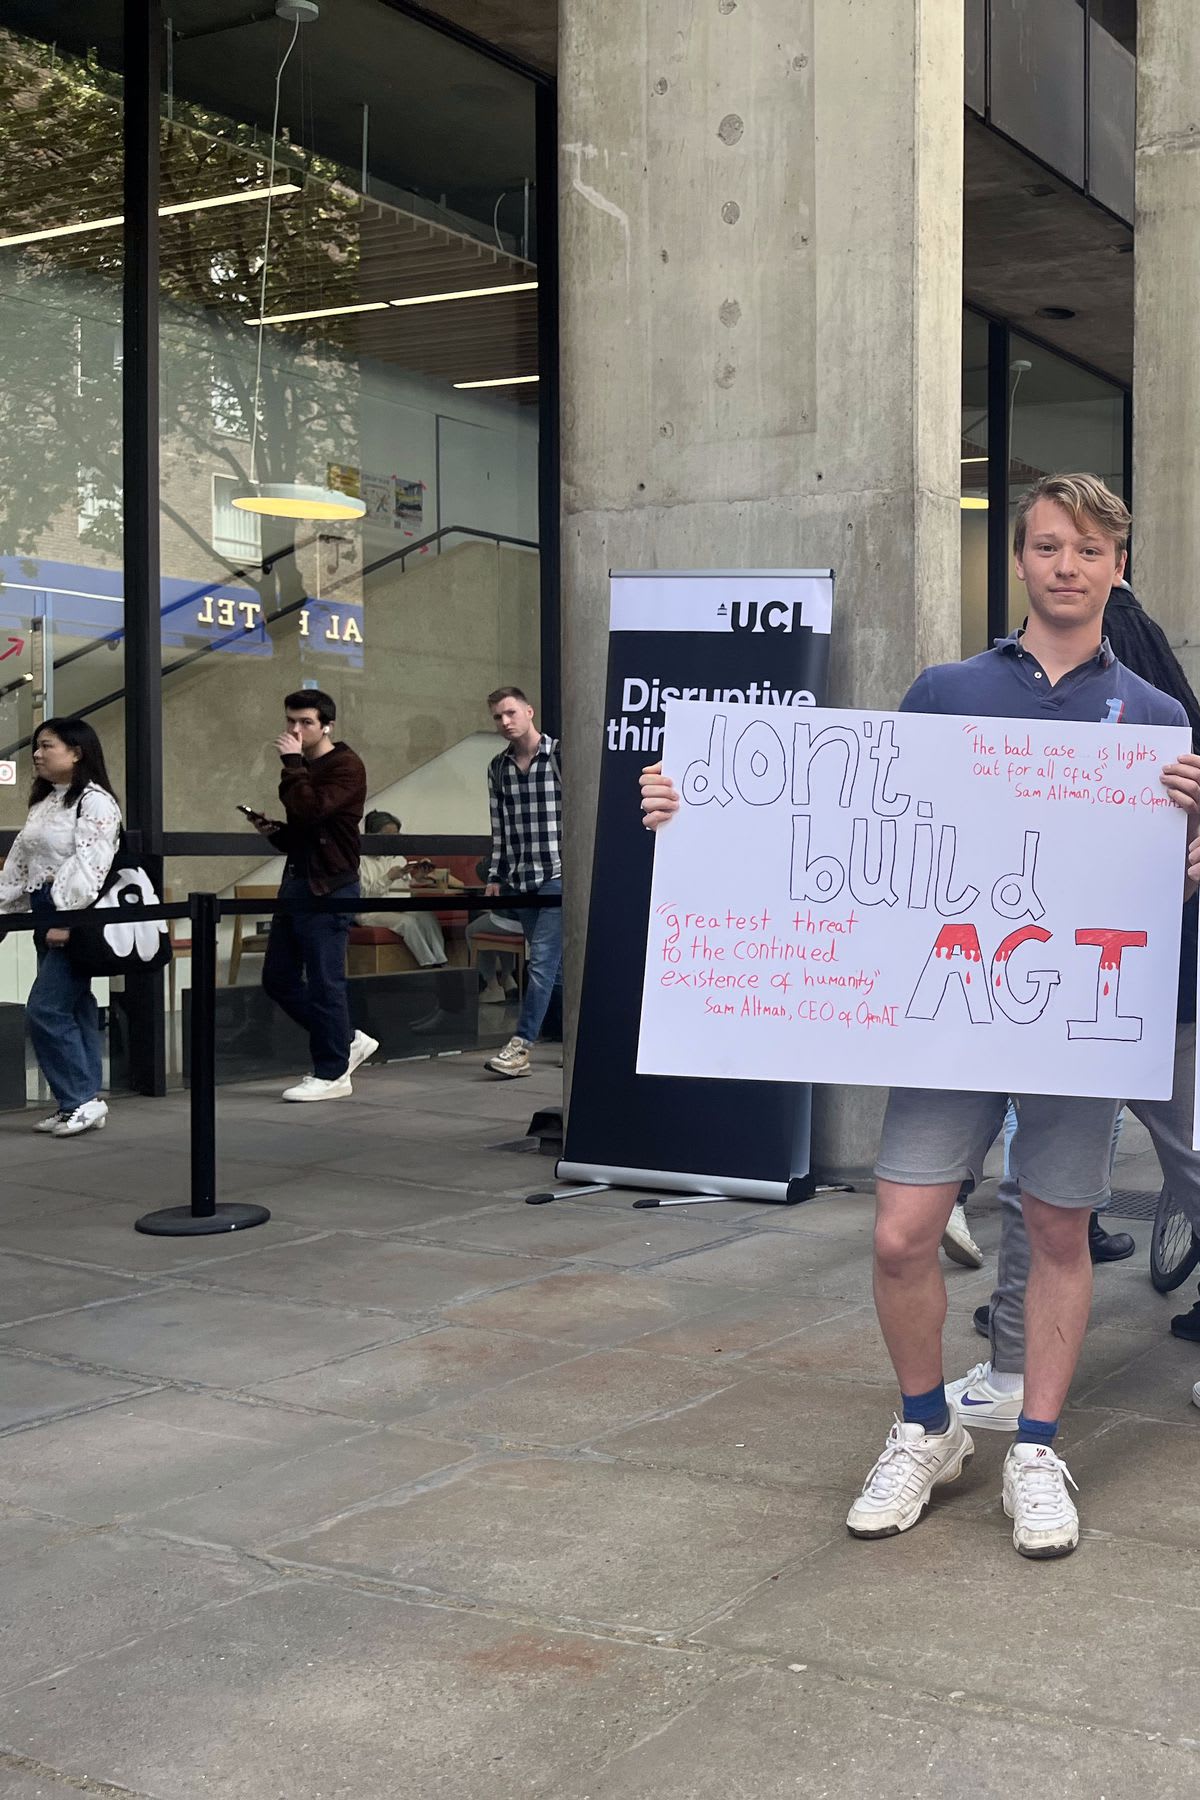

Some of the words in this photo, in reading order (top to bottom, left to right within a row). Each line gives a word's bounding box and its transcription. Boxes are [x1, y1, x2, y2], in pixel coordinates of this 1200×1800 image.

[731, 601, 813, 632] UCL
[682, 714, 911, 817] don't
[1005, 734, 1032, 756] bad
[1044, 745, 1075, 758] case
[1098, 747, 1108, 760] is
[1117, 743, 1157, 769] lights
[1008, 762, 1031, 782] for
[1037, 759, 1054, 779] all
[1015, 783, 1041, 797] Sam
[1097, 786, 1125, 804] CEO
[790, 801, 1045, 921] build
[793, 909, 859, 934] threat
[661, 939, 681, 963] to
[691, 936, 725, 961] the
[660, 967, 760, 989] existence
[770, 973, 793, 994] of
[905, 924, 1147, 1042] AGI
[704, 996, 734, 1015] Sam
[798, 1000, 834, 1021] CEO
[838, 1011, 852, 1028] of
[856, 1002, 899, 1029] OpenAI
